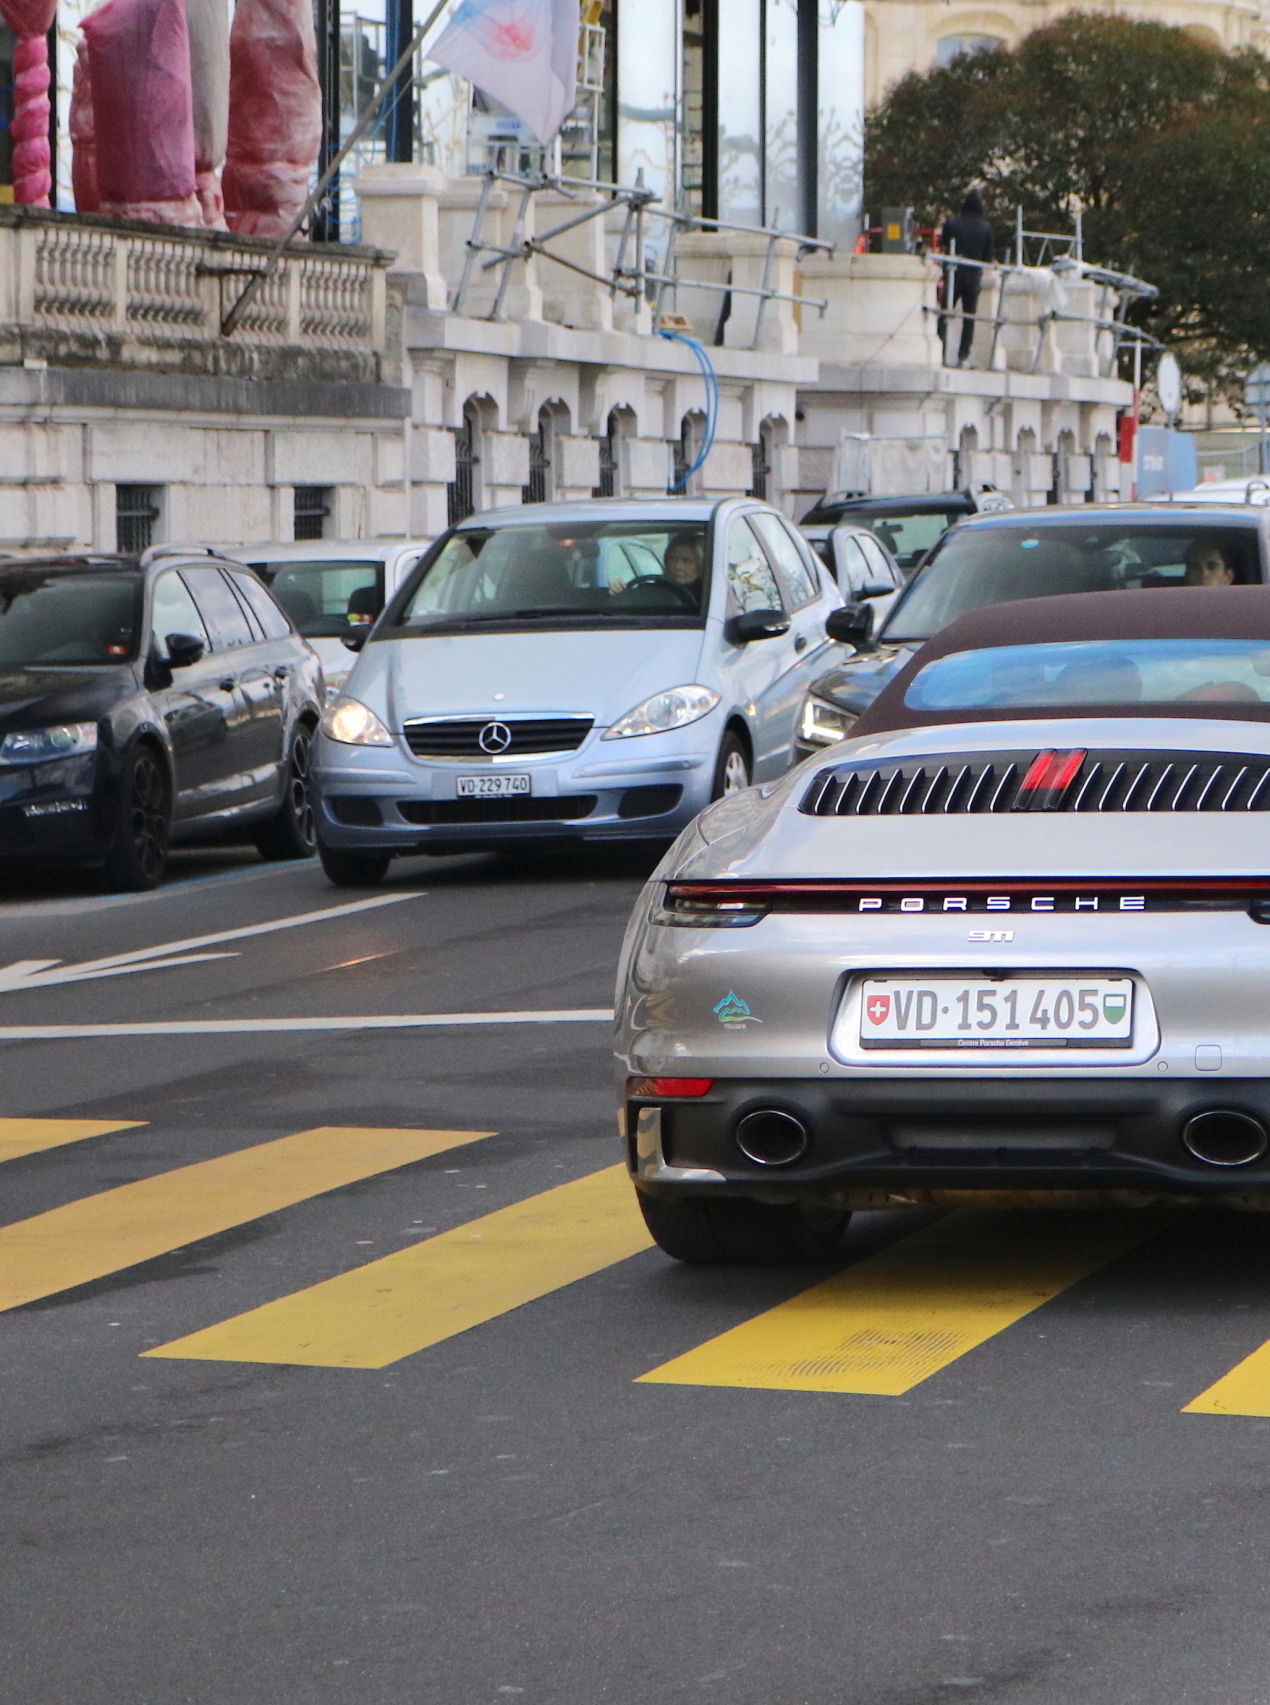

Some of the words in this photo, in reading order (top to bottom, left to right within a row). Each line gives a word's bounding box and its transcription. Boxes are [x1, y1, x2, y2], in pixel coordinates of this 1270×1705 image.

[858, 895, 1145, 912] PORSCHE
[967, 929, 1015, 942] 911
[957, 1039, 979, 1047] Centre
[979, 1039, 1004, 1047] Porsche
[1005, 1038, 1029, 1047] Genève
